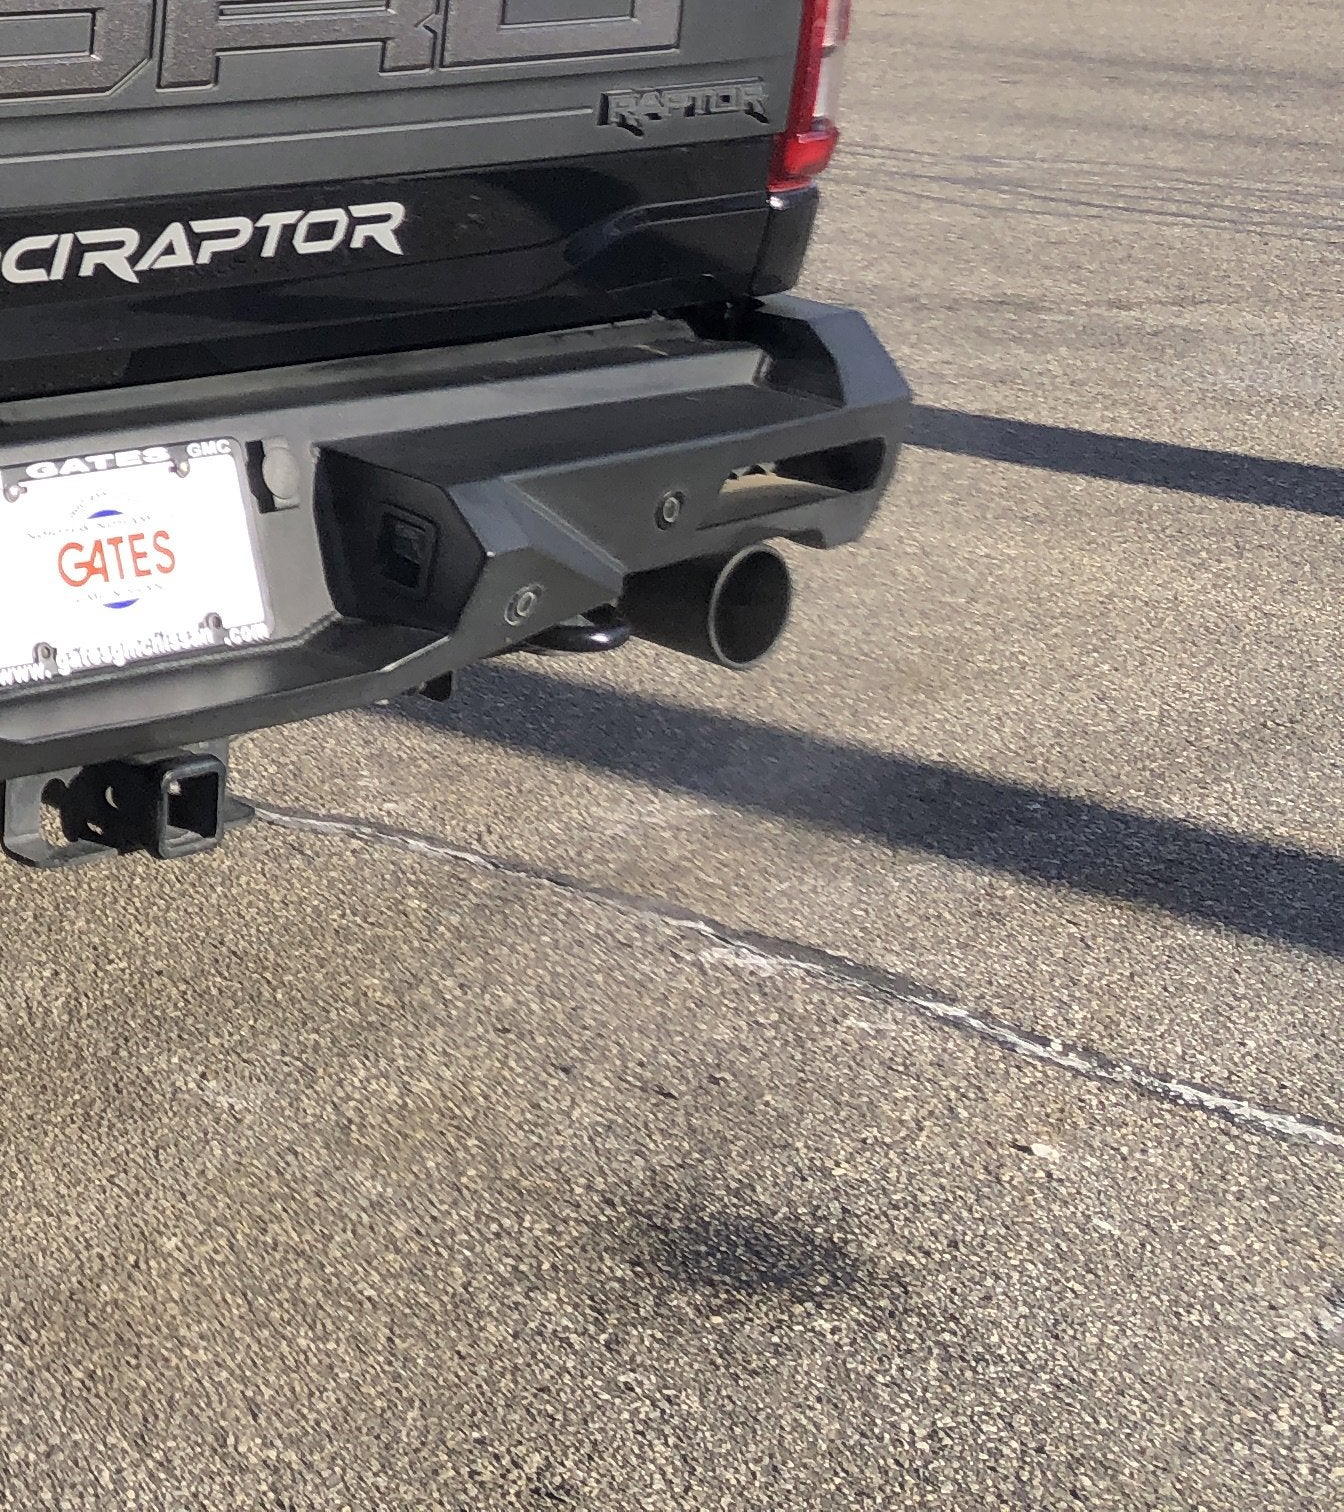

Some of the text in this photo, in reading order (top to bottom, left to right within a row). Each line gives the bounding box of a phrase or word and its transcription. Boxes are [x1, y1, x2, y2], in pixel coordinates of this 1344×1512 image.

[598, 78, 769, 137] RAPTOR
[25, 447, 169, 479] GATES
[185, 439, 231, 457] GMC
[57, 530, 176, 587] GATES
